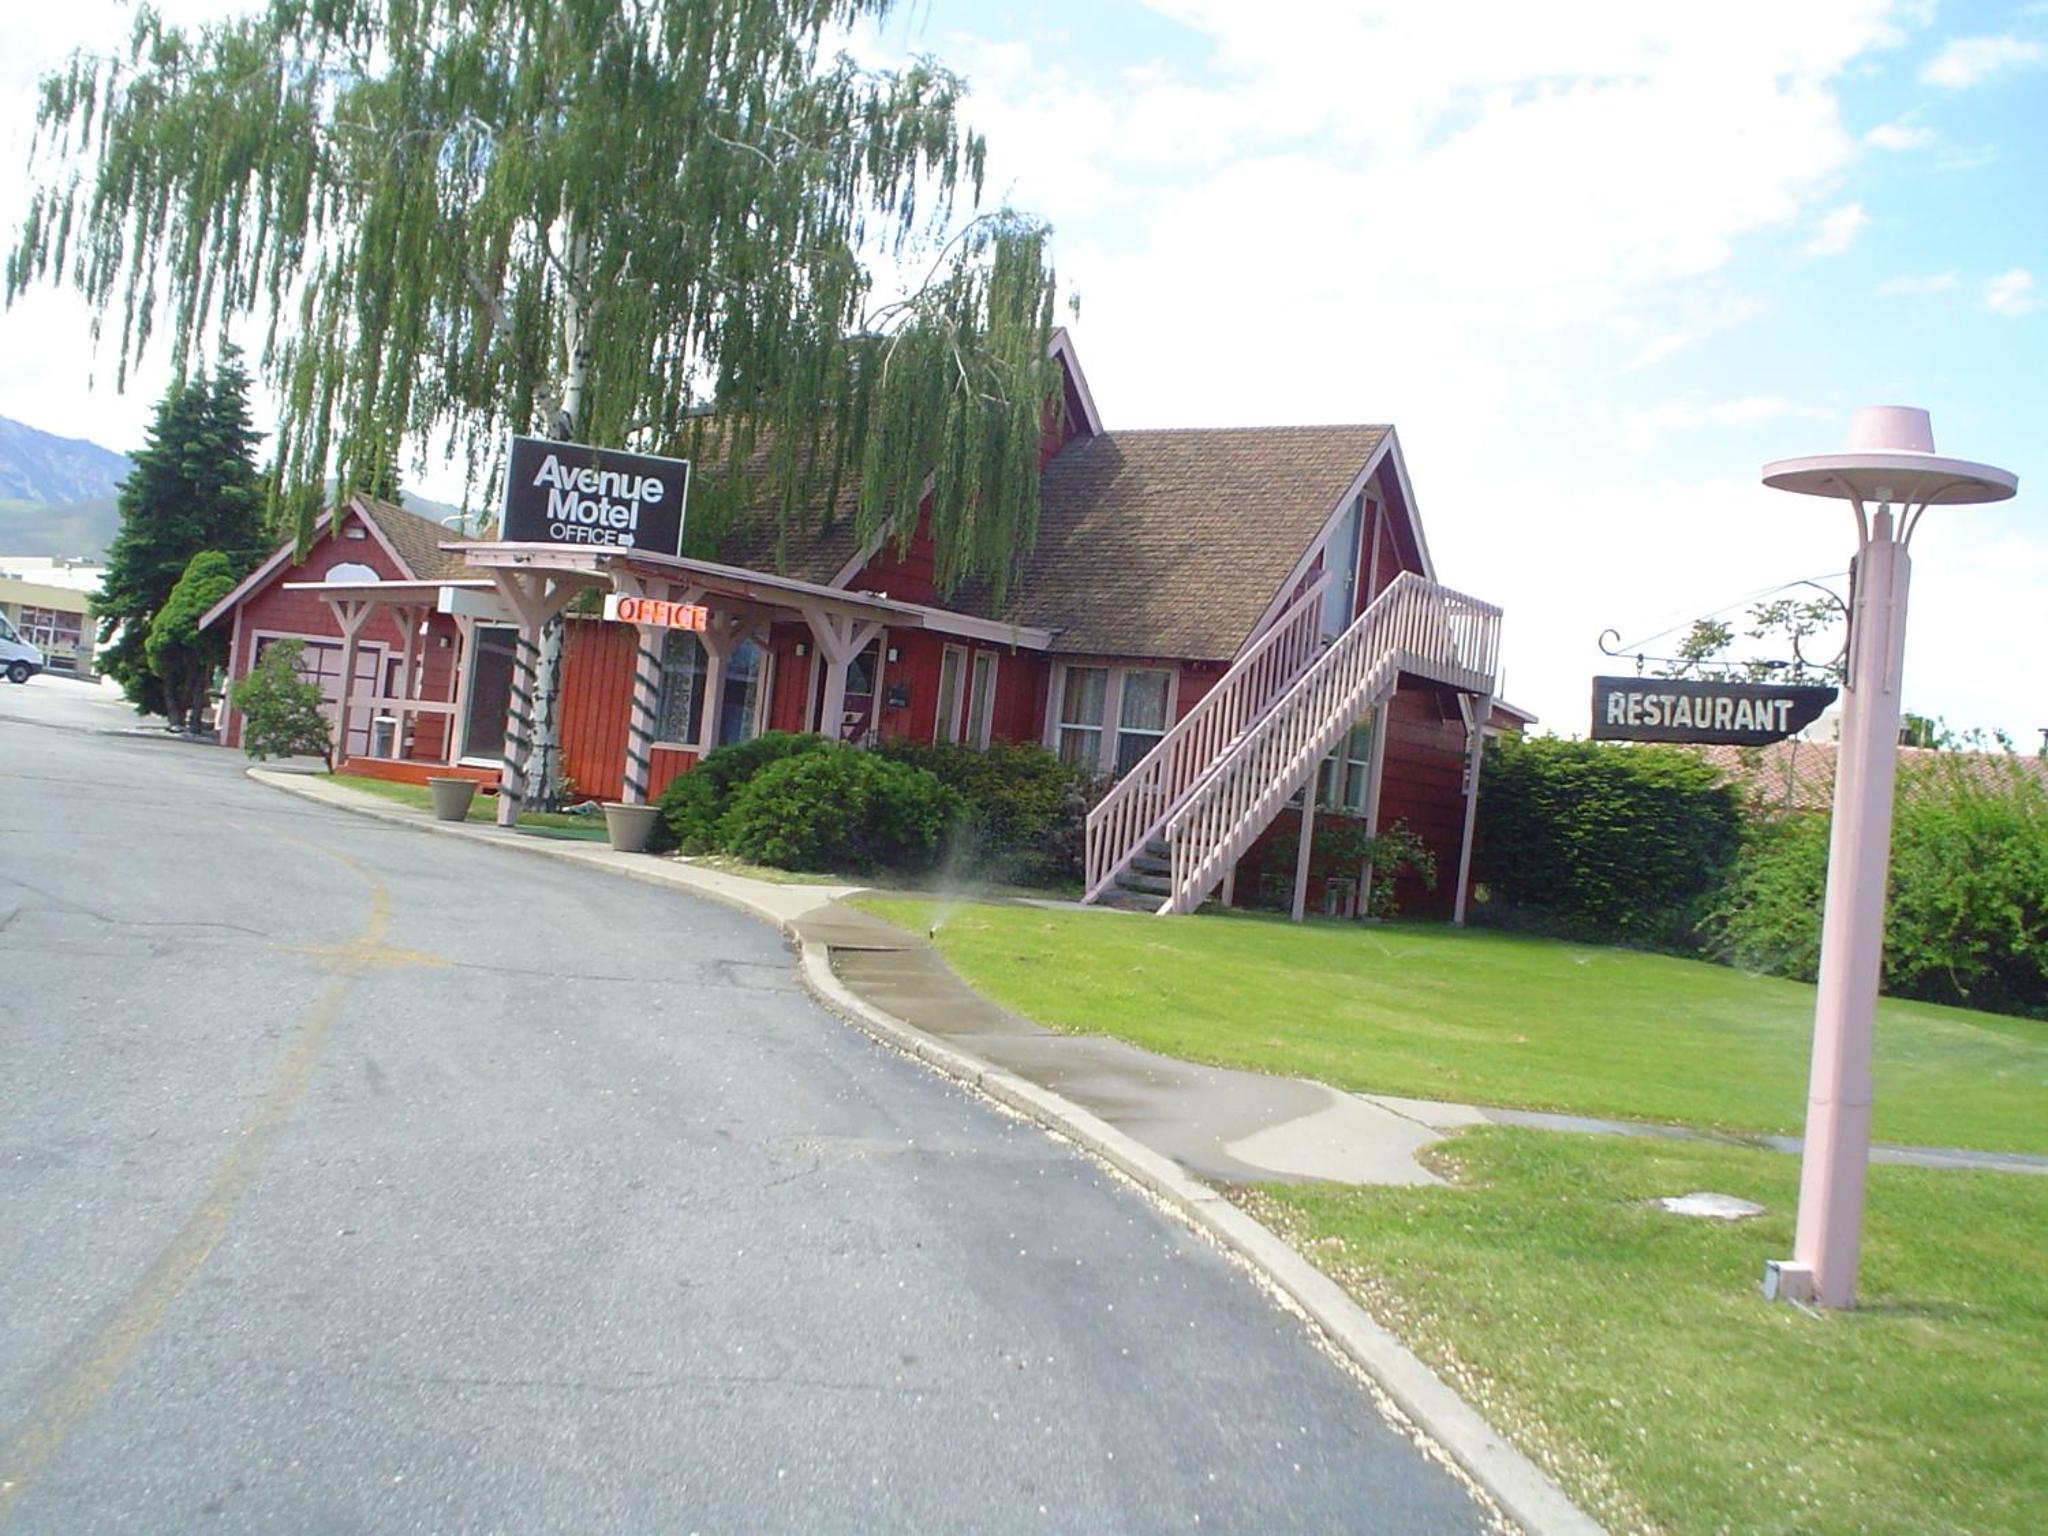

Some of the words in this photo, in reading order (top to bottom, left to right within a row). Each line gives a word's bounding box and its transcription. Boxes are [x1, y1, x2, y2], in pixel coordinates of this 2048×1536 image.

[533, 454, 664, 503] Avenue
[547, 488, 639, 530] Motel
[550, 523, 617, 546] OFFICE
[618, 598, 707, 630] OFFICE
[1607, 691, 1793, 732] RESTAURANT
